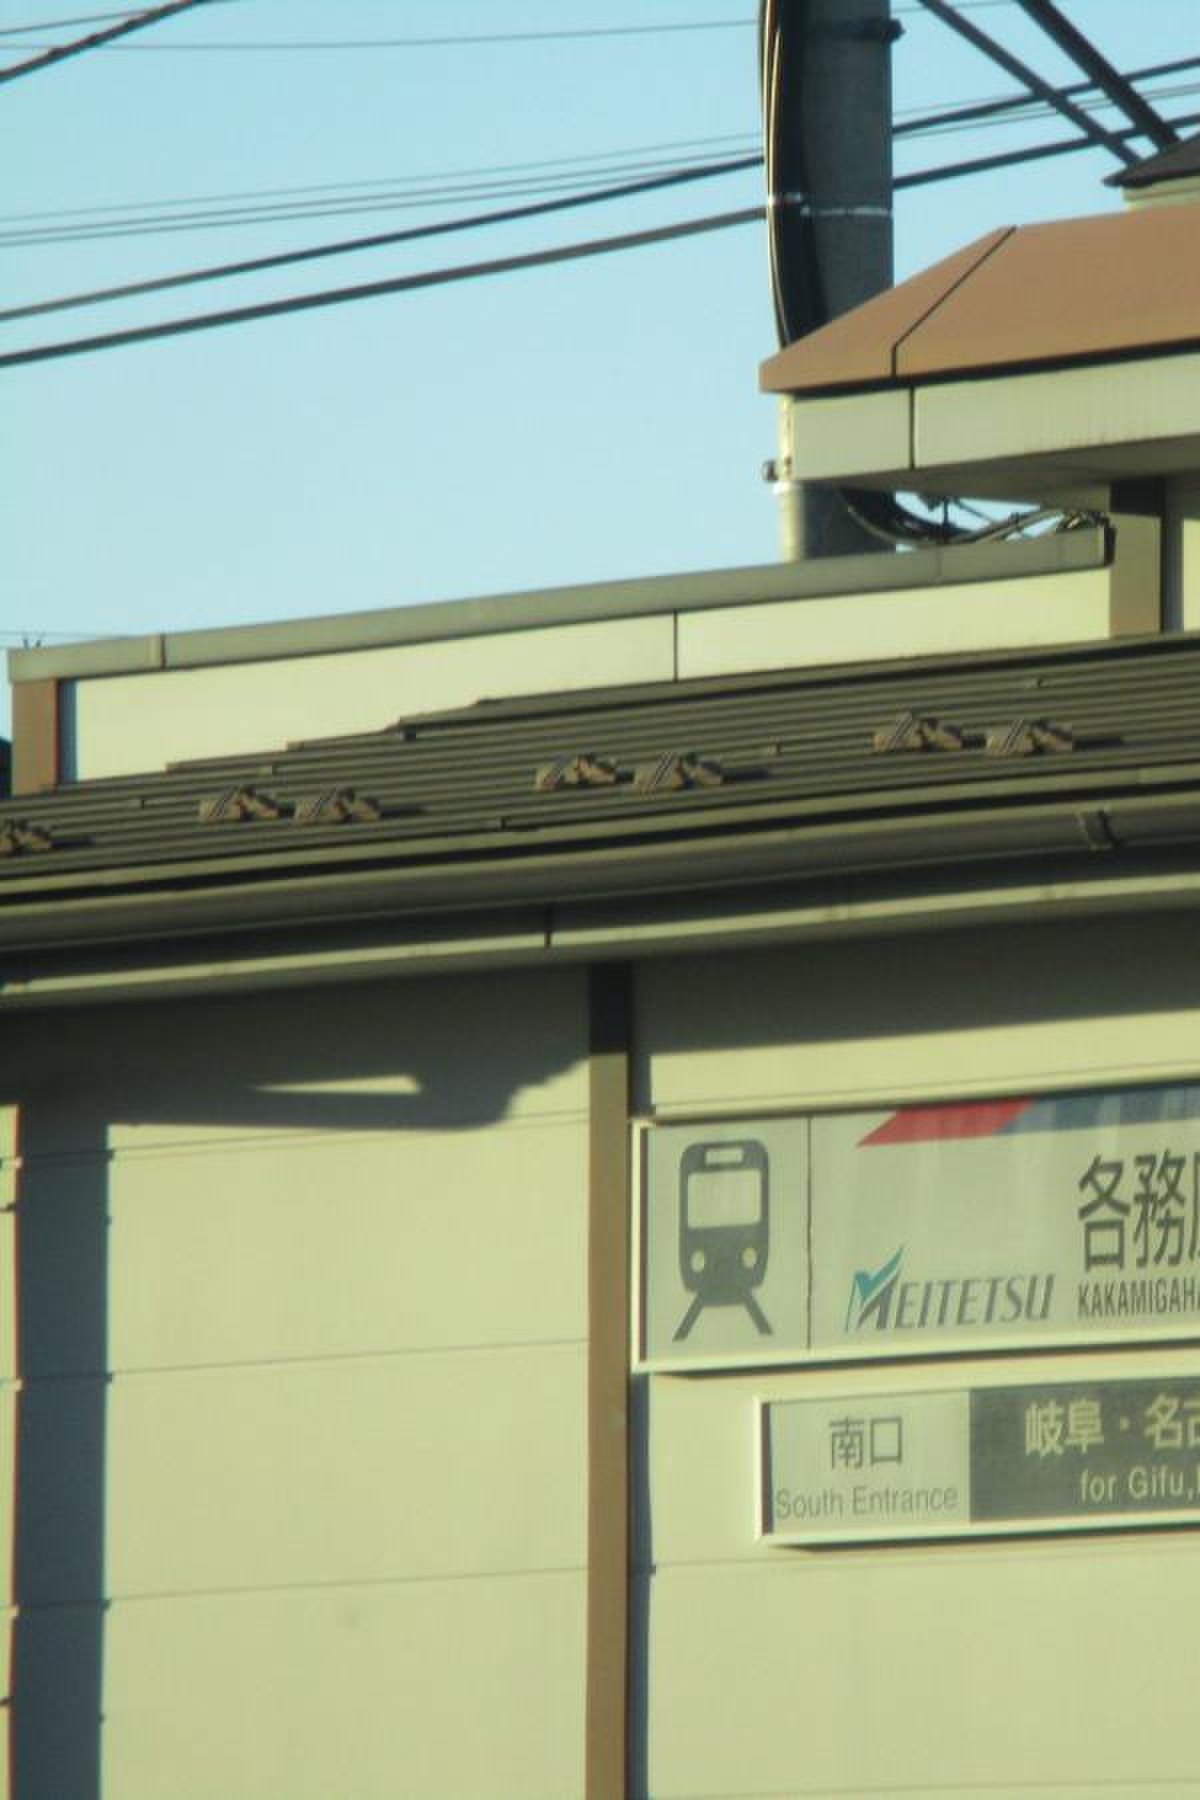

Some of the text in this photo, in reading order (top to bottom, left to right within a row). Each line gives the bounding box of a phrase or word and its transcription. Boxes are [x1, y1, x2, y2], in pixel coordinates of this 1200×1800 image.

[845, 1245, 1055, 1333] MEITETSU
[829, 1416, 903, 1469] 南口
[775, 1484, 960, 1519] South Entrance
[1080, 1471, 1118, 1502] for
